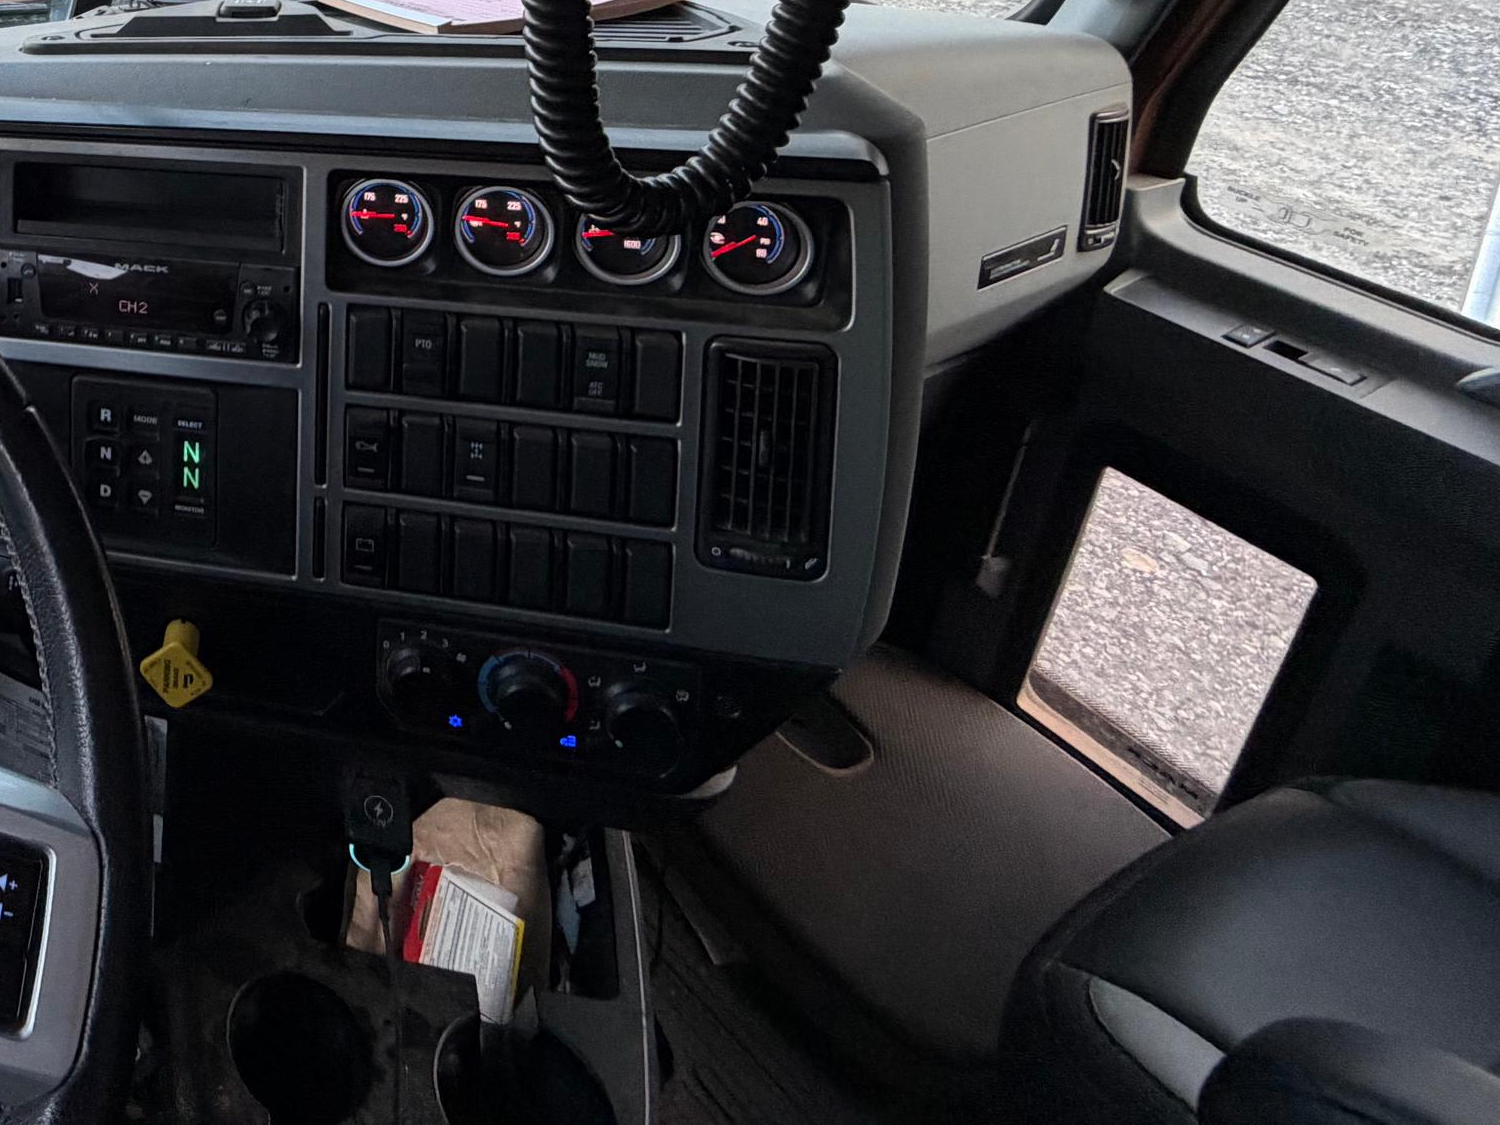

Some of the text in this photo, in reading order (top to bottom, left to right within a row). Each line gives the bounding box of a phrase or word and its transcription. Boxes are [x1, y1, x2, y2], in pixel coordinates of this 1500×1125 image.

[394, 193, 409, 204] 225
[1226, 185, 1261, 201] BUCKLE
[506, 201, 521, 211] 225
[1333, 231, 1370, 246] SAFETY
[1344, 227, 1364, 237] FOR
[114, 262, 169, 273] MACK
[118, 299, 149, 314] CH2
[100, 408, 112, 422] R
[177, 419, 203, 429] SELECT
[100, 446, 112, 460] N
[183, 440, 200, 464] N
[183, 466, 200, 490] N
[100, 484, 112, 497] D
